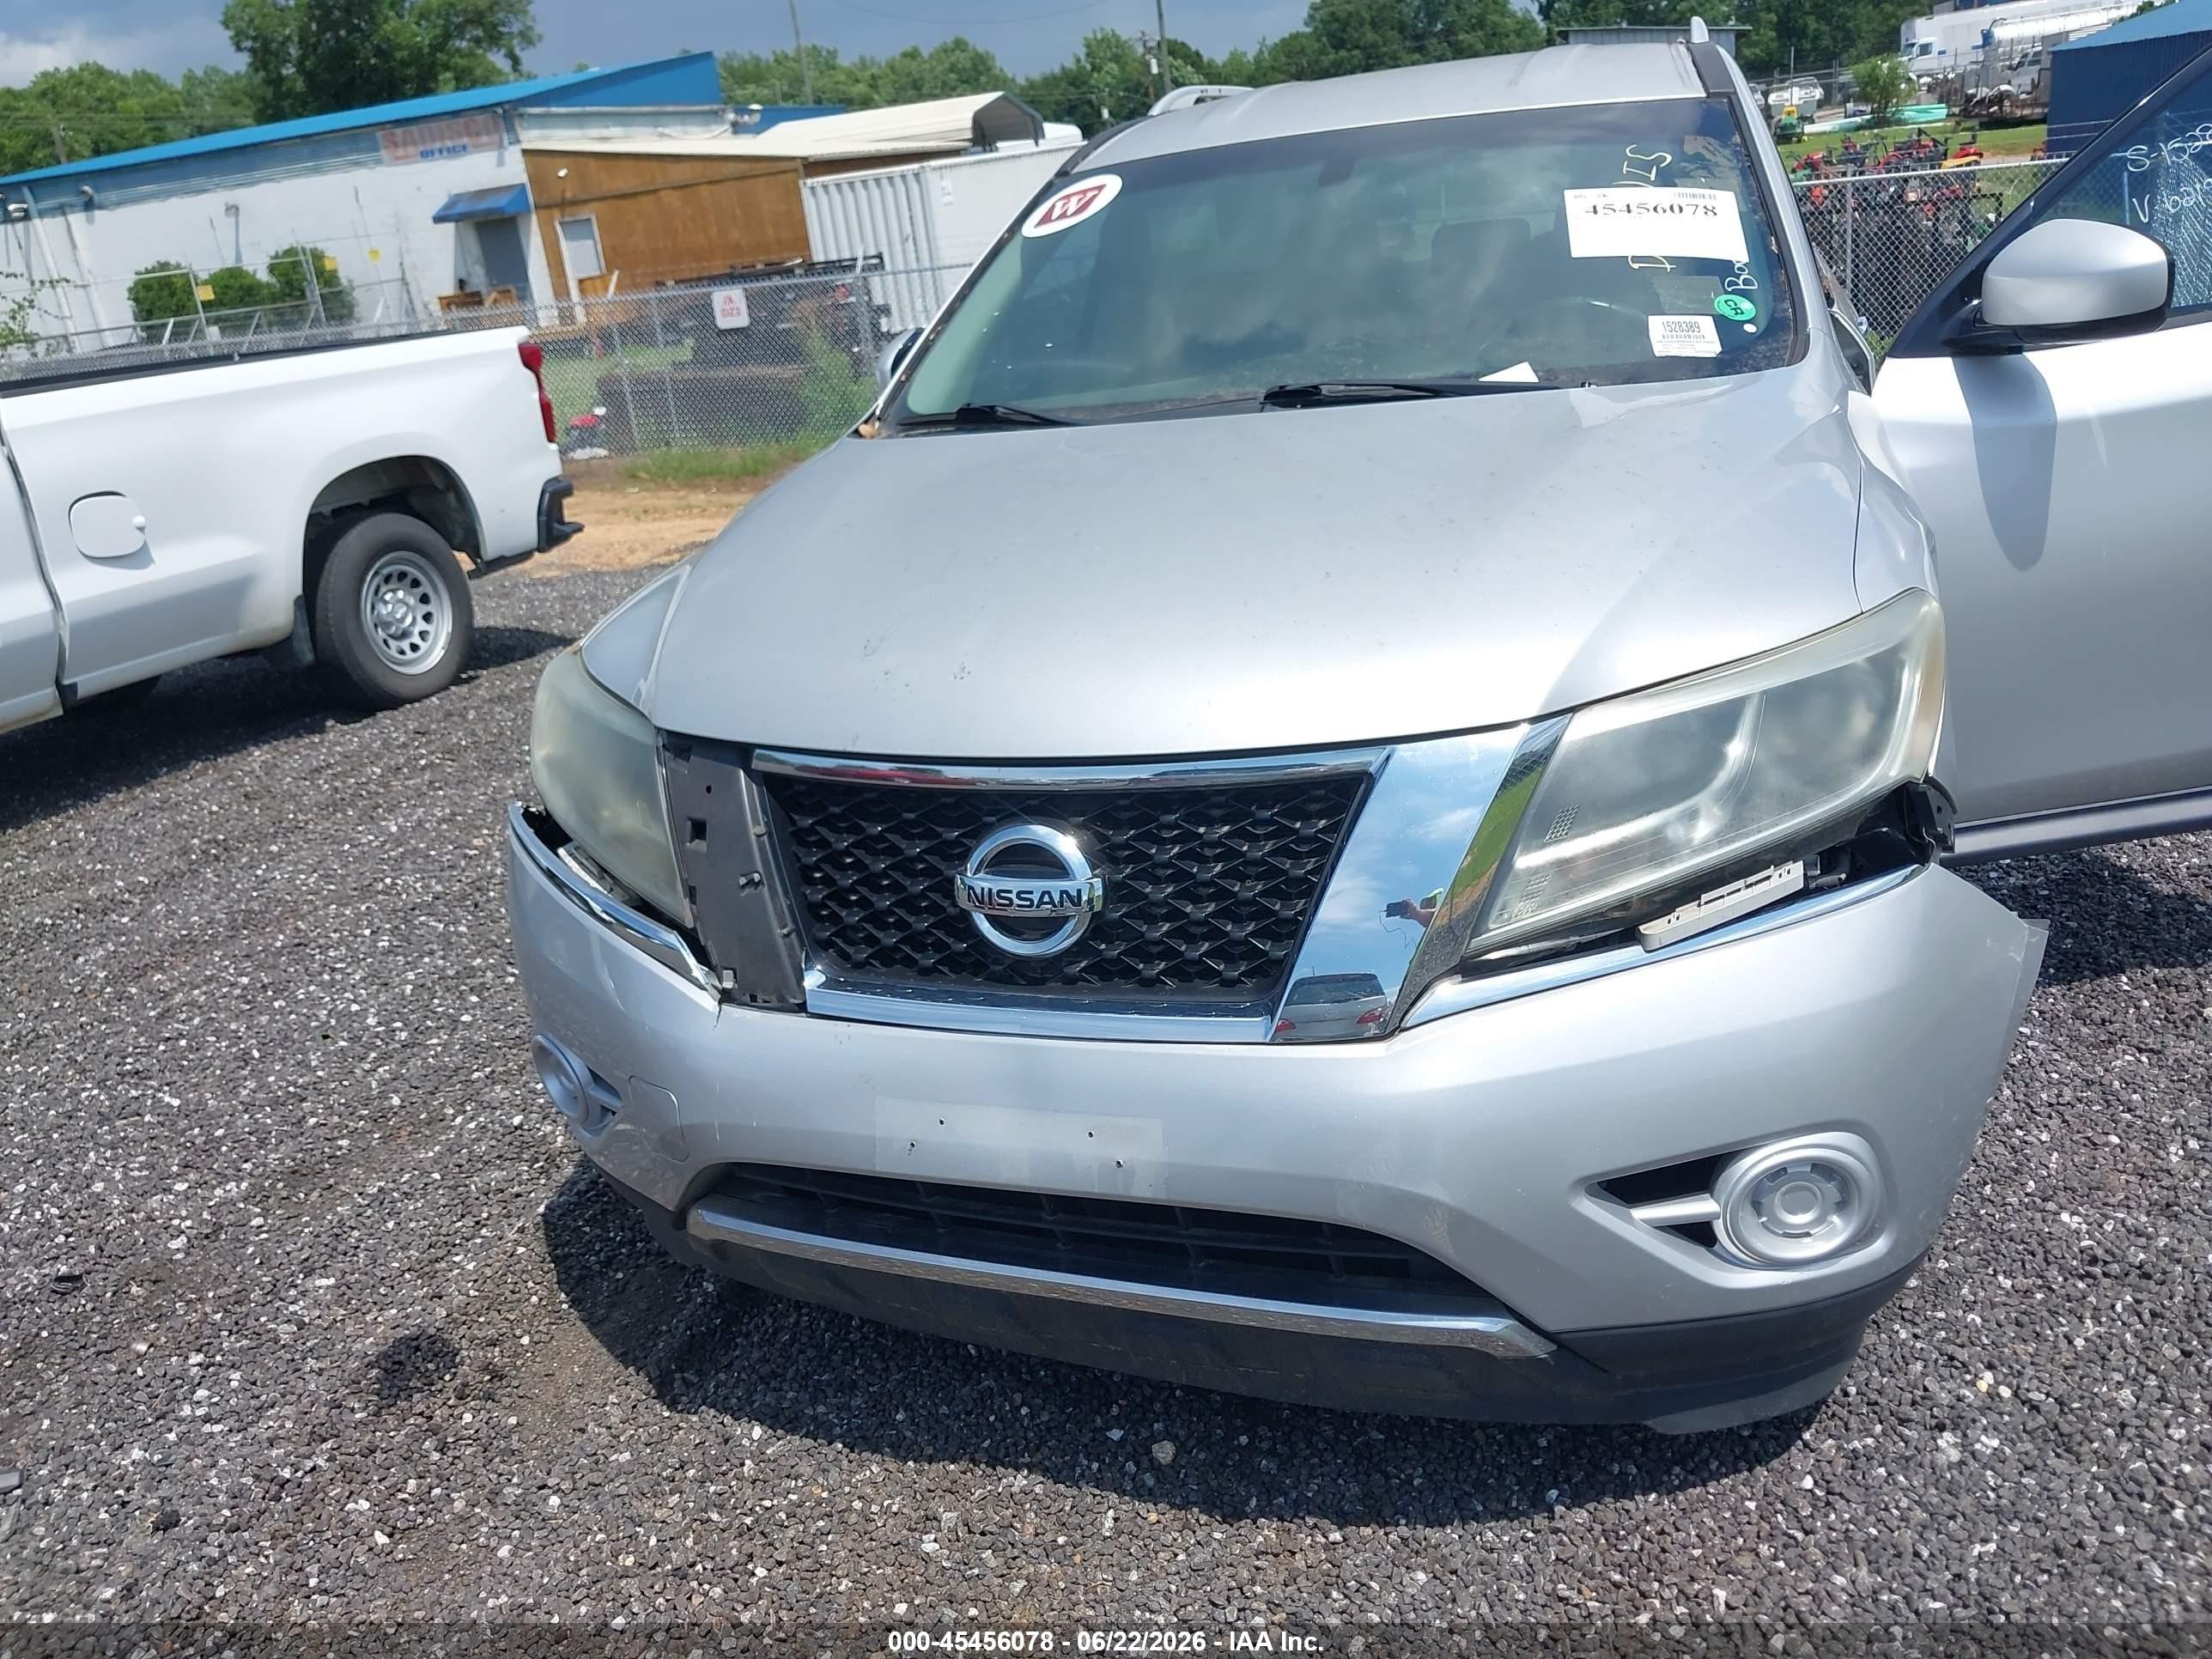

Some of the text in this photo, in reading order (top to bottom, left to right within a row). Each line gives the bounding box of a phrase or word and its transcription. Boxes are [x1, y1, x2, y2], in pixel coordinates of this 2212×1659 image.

[1584, 203, 1718, 216] 45456078
[1662, 320, 1701, 333] 1528389
[967, 884, 1083, 909] NISSAN
